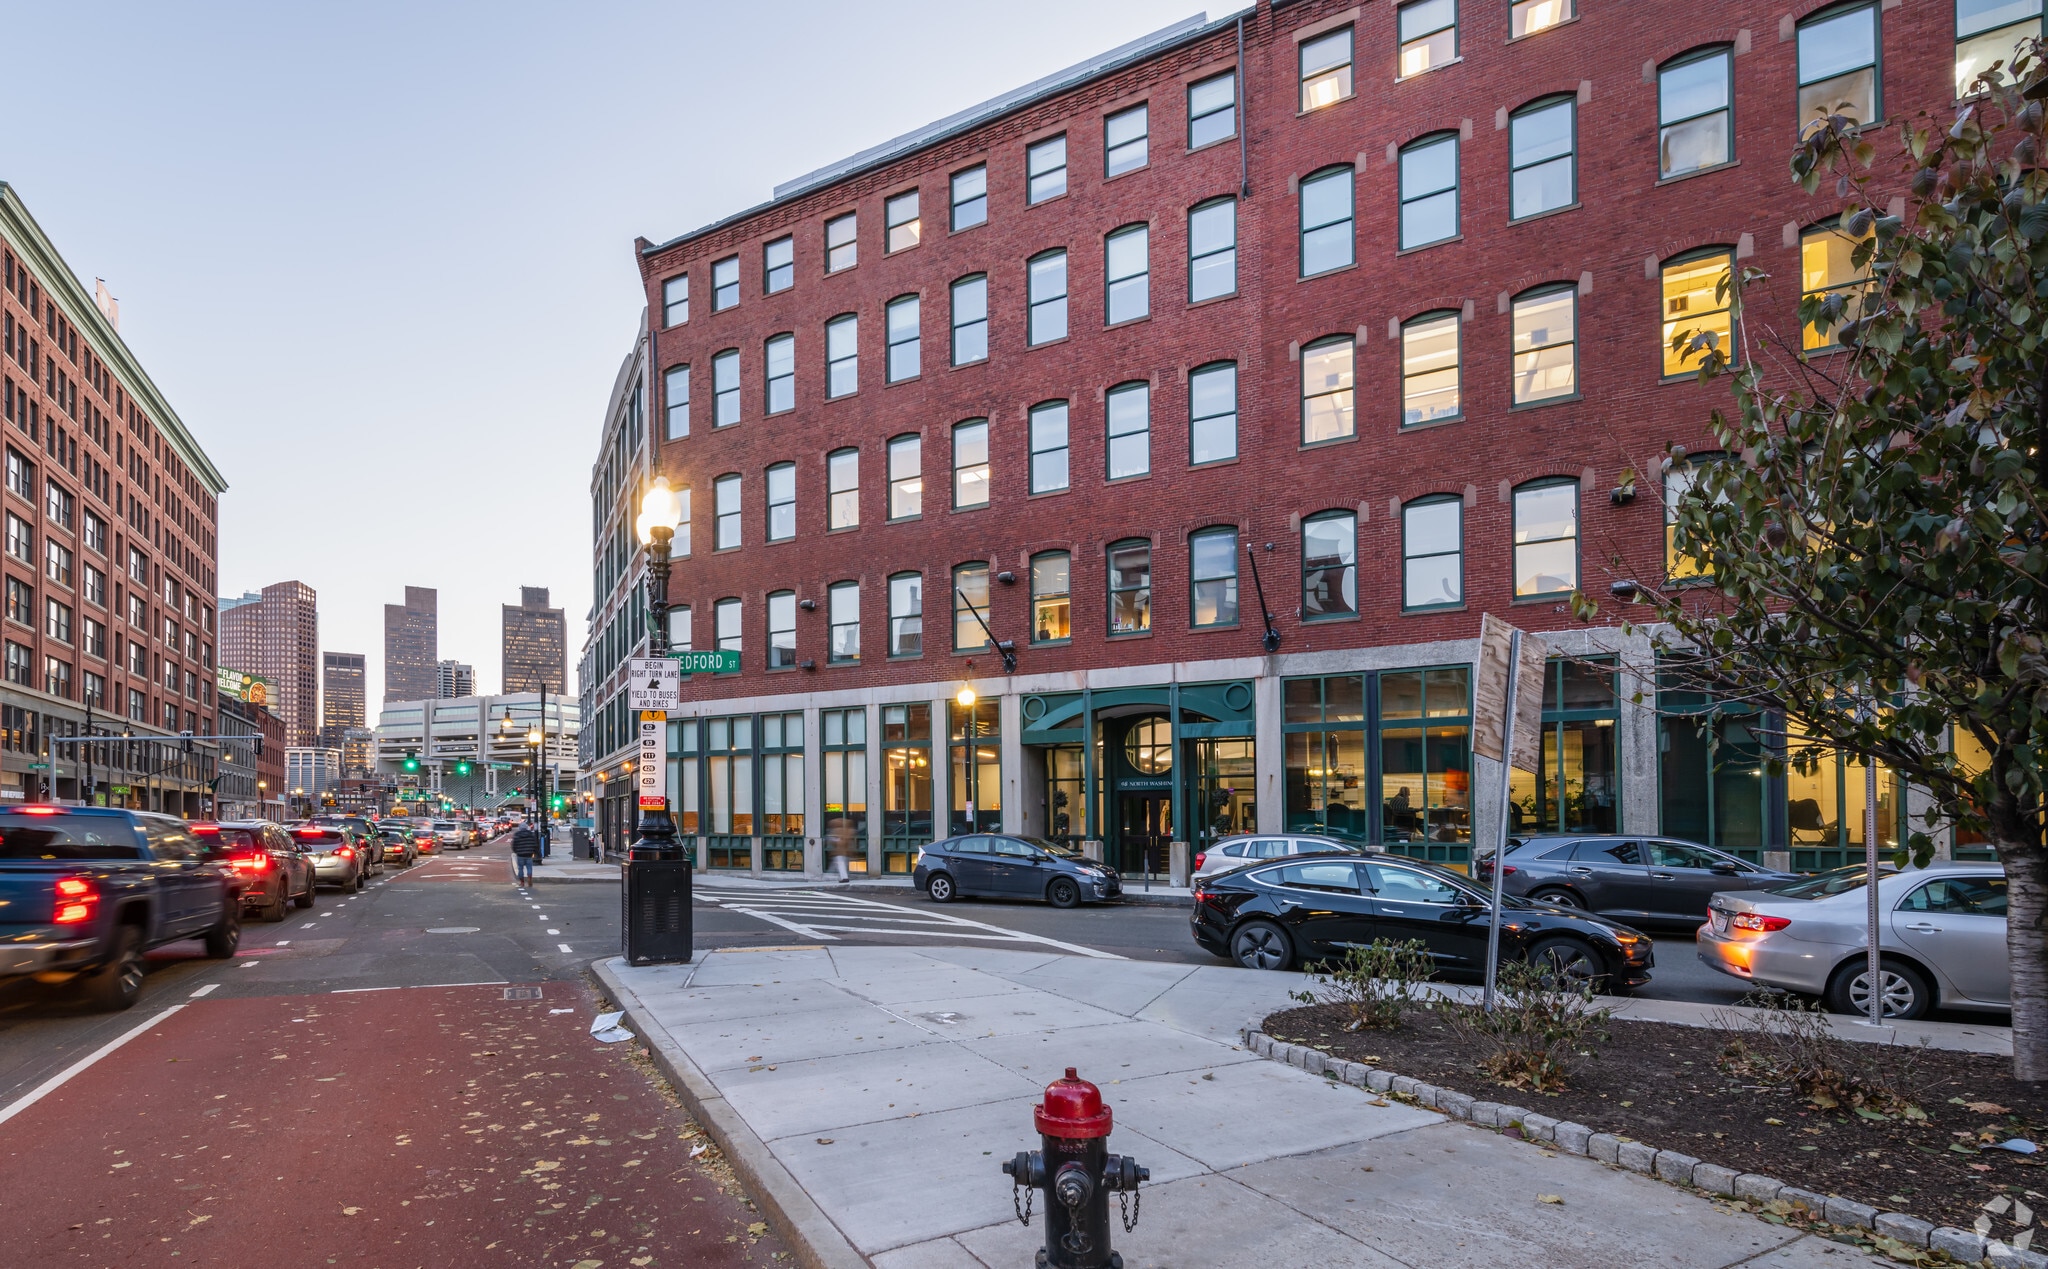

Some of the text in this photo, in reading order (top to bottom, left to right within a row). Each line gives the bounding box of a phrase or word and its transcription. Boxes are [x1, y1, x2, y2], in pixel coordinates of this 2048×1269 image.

[645, 661, 664, 669] BEGIN
[729, 660, 736, 668] ST
[649, 670, 663, 678] TURN
[664, 670, 678, 678] LANE
[631, 690, 647, 698] YIELD
[658, 690, 677, 699] BUSES
[652, 700, 669, 708] BIKES
